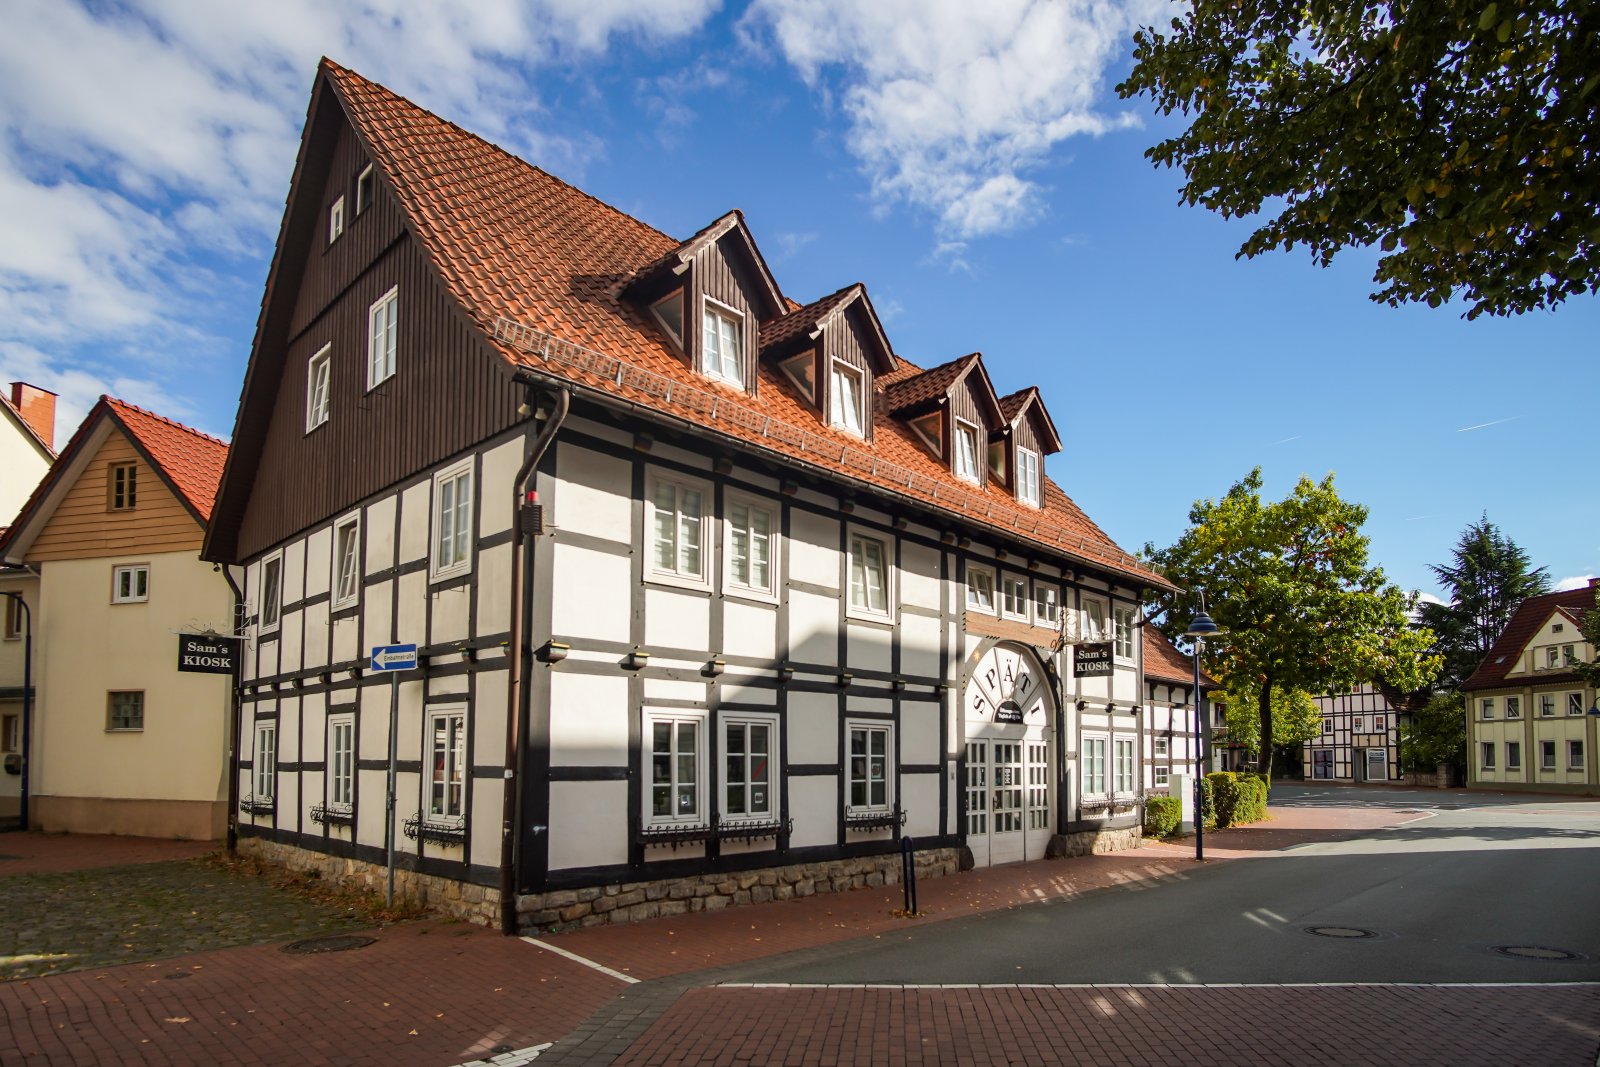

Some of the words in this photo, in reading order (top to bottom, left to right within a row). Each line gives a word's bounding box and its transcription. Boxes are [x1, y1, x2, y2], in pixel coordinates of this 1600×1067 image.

[183, 655, 232, 668] KIOSK
[1076, 661, 1110, 672] KIOSK
[973, 658, 1040, 715] SPÄTI
